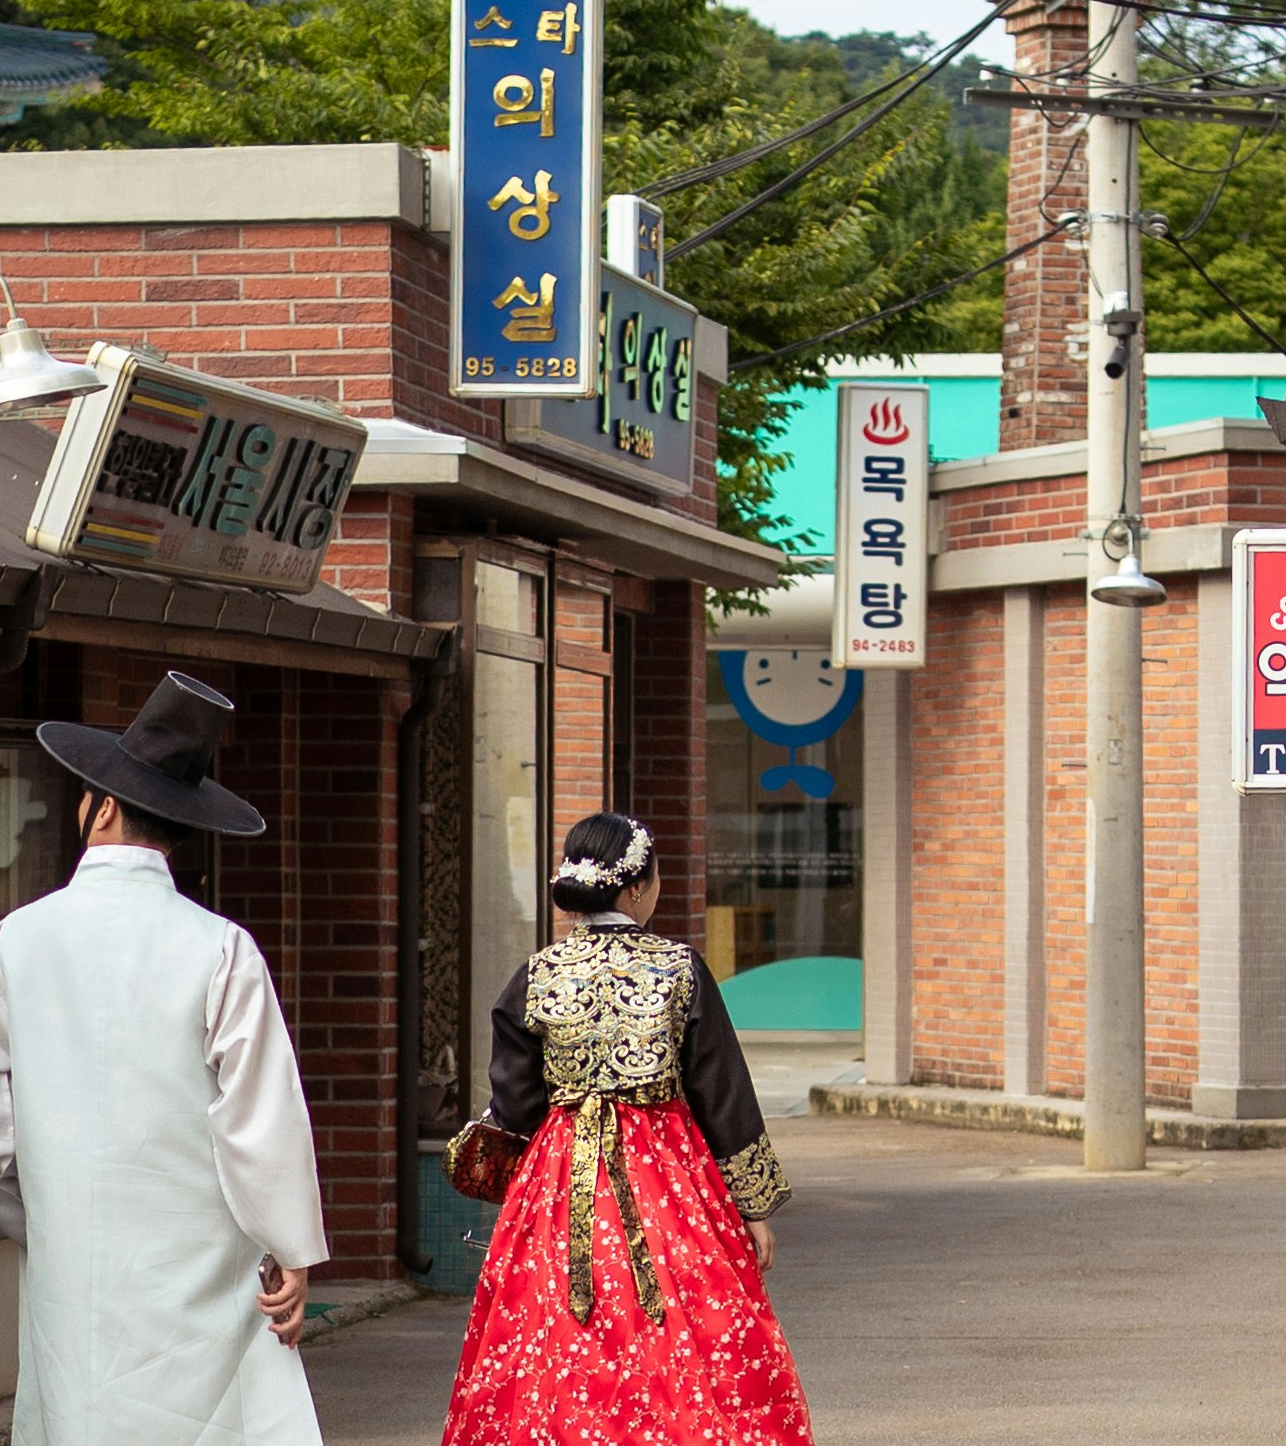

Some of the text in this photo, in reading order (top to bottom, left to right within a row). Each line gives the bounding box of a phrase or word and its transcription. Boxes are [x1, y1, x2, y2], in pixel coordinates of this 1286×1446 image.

[469, 1, 582, 56] 스타
[486, 66, 561, 343] 의상실
[860, 456, 908, 629] 목욕탕
